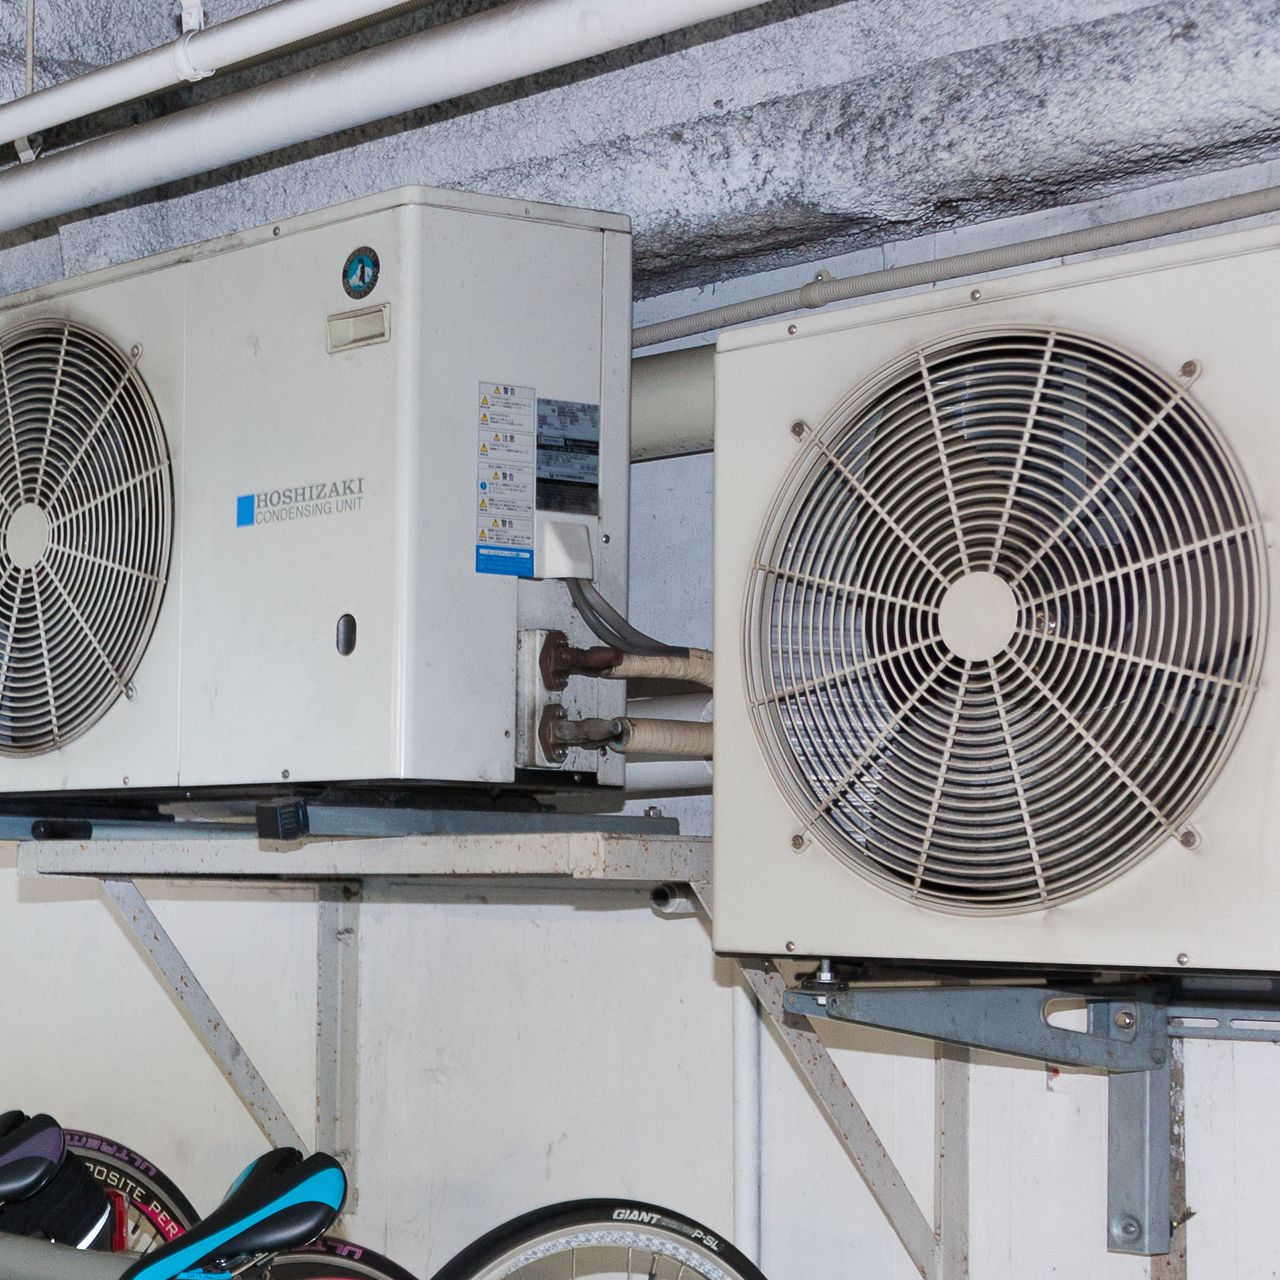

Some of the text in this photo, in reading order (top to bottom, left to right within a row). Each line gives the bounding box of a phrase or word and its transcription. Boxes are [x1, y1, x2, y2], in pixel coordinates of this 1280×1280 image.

[256, 478, 364, 509] HOSHIZAKI
[256, 497, 364, 525] CONDENSING UNIT
[613, 1209, 662, 1225] GIANT
